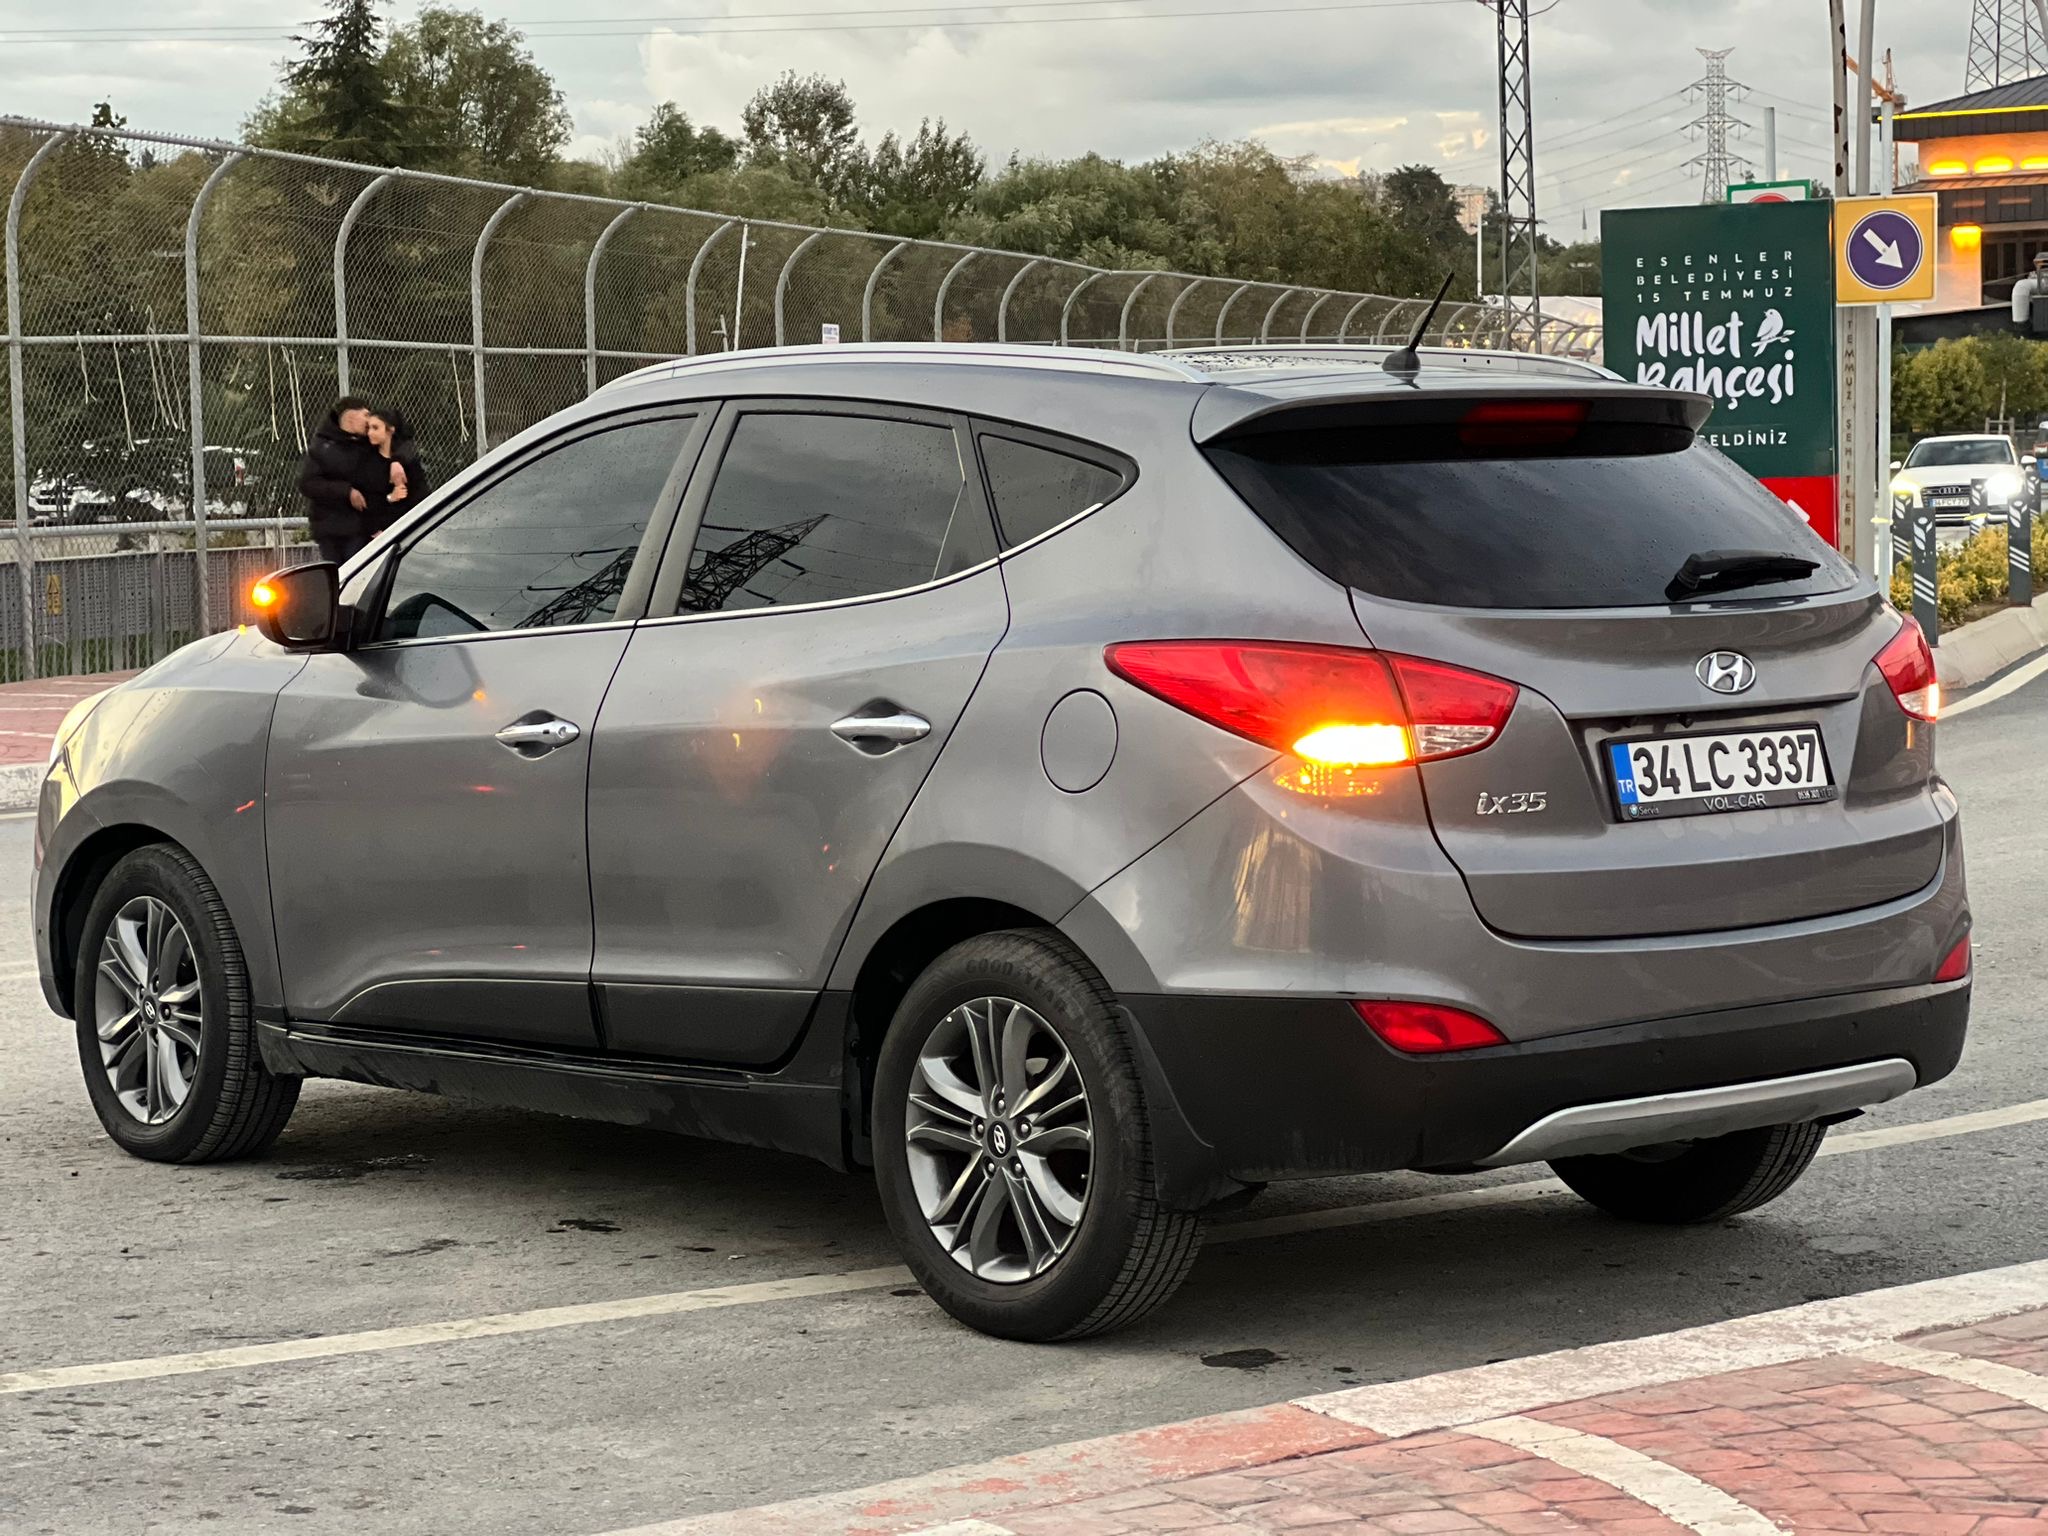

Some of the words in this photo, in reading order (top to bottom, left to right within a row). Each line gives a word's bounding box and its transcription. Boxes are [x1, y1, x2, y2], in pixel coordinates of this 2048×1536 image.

[1636, 251, 1793, 268] ESENLER
[1636, 266, 1793, 286] BELEDİYESİ
[1636, 293, 1660, 304] 15
[1684, 287, 1793, 302] TEMMUZ
[1636, 310, 1744, 359] Millet
[1844, 320, 1855, 401] TEMMUZ
[1637, 349, 1795, 410] Bahçesi
[1697, 429, 1788, 447] ELDİNİZ
[1633, 745, 1681, 797] 34
[1683, 741, 1735, 792] LC
[1739, 734, 1816, 787] 3337
[1618, 780, 1635, 794] TR
[1476, 791, 1547, 815] ix35
[1704, 793, 1767, 811] VOL-CAR
